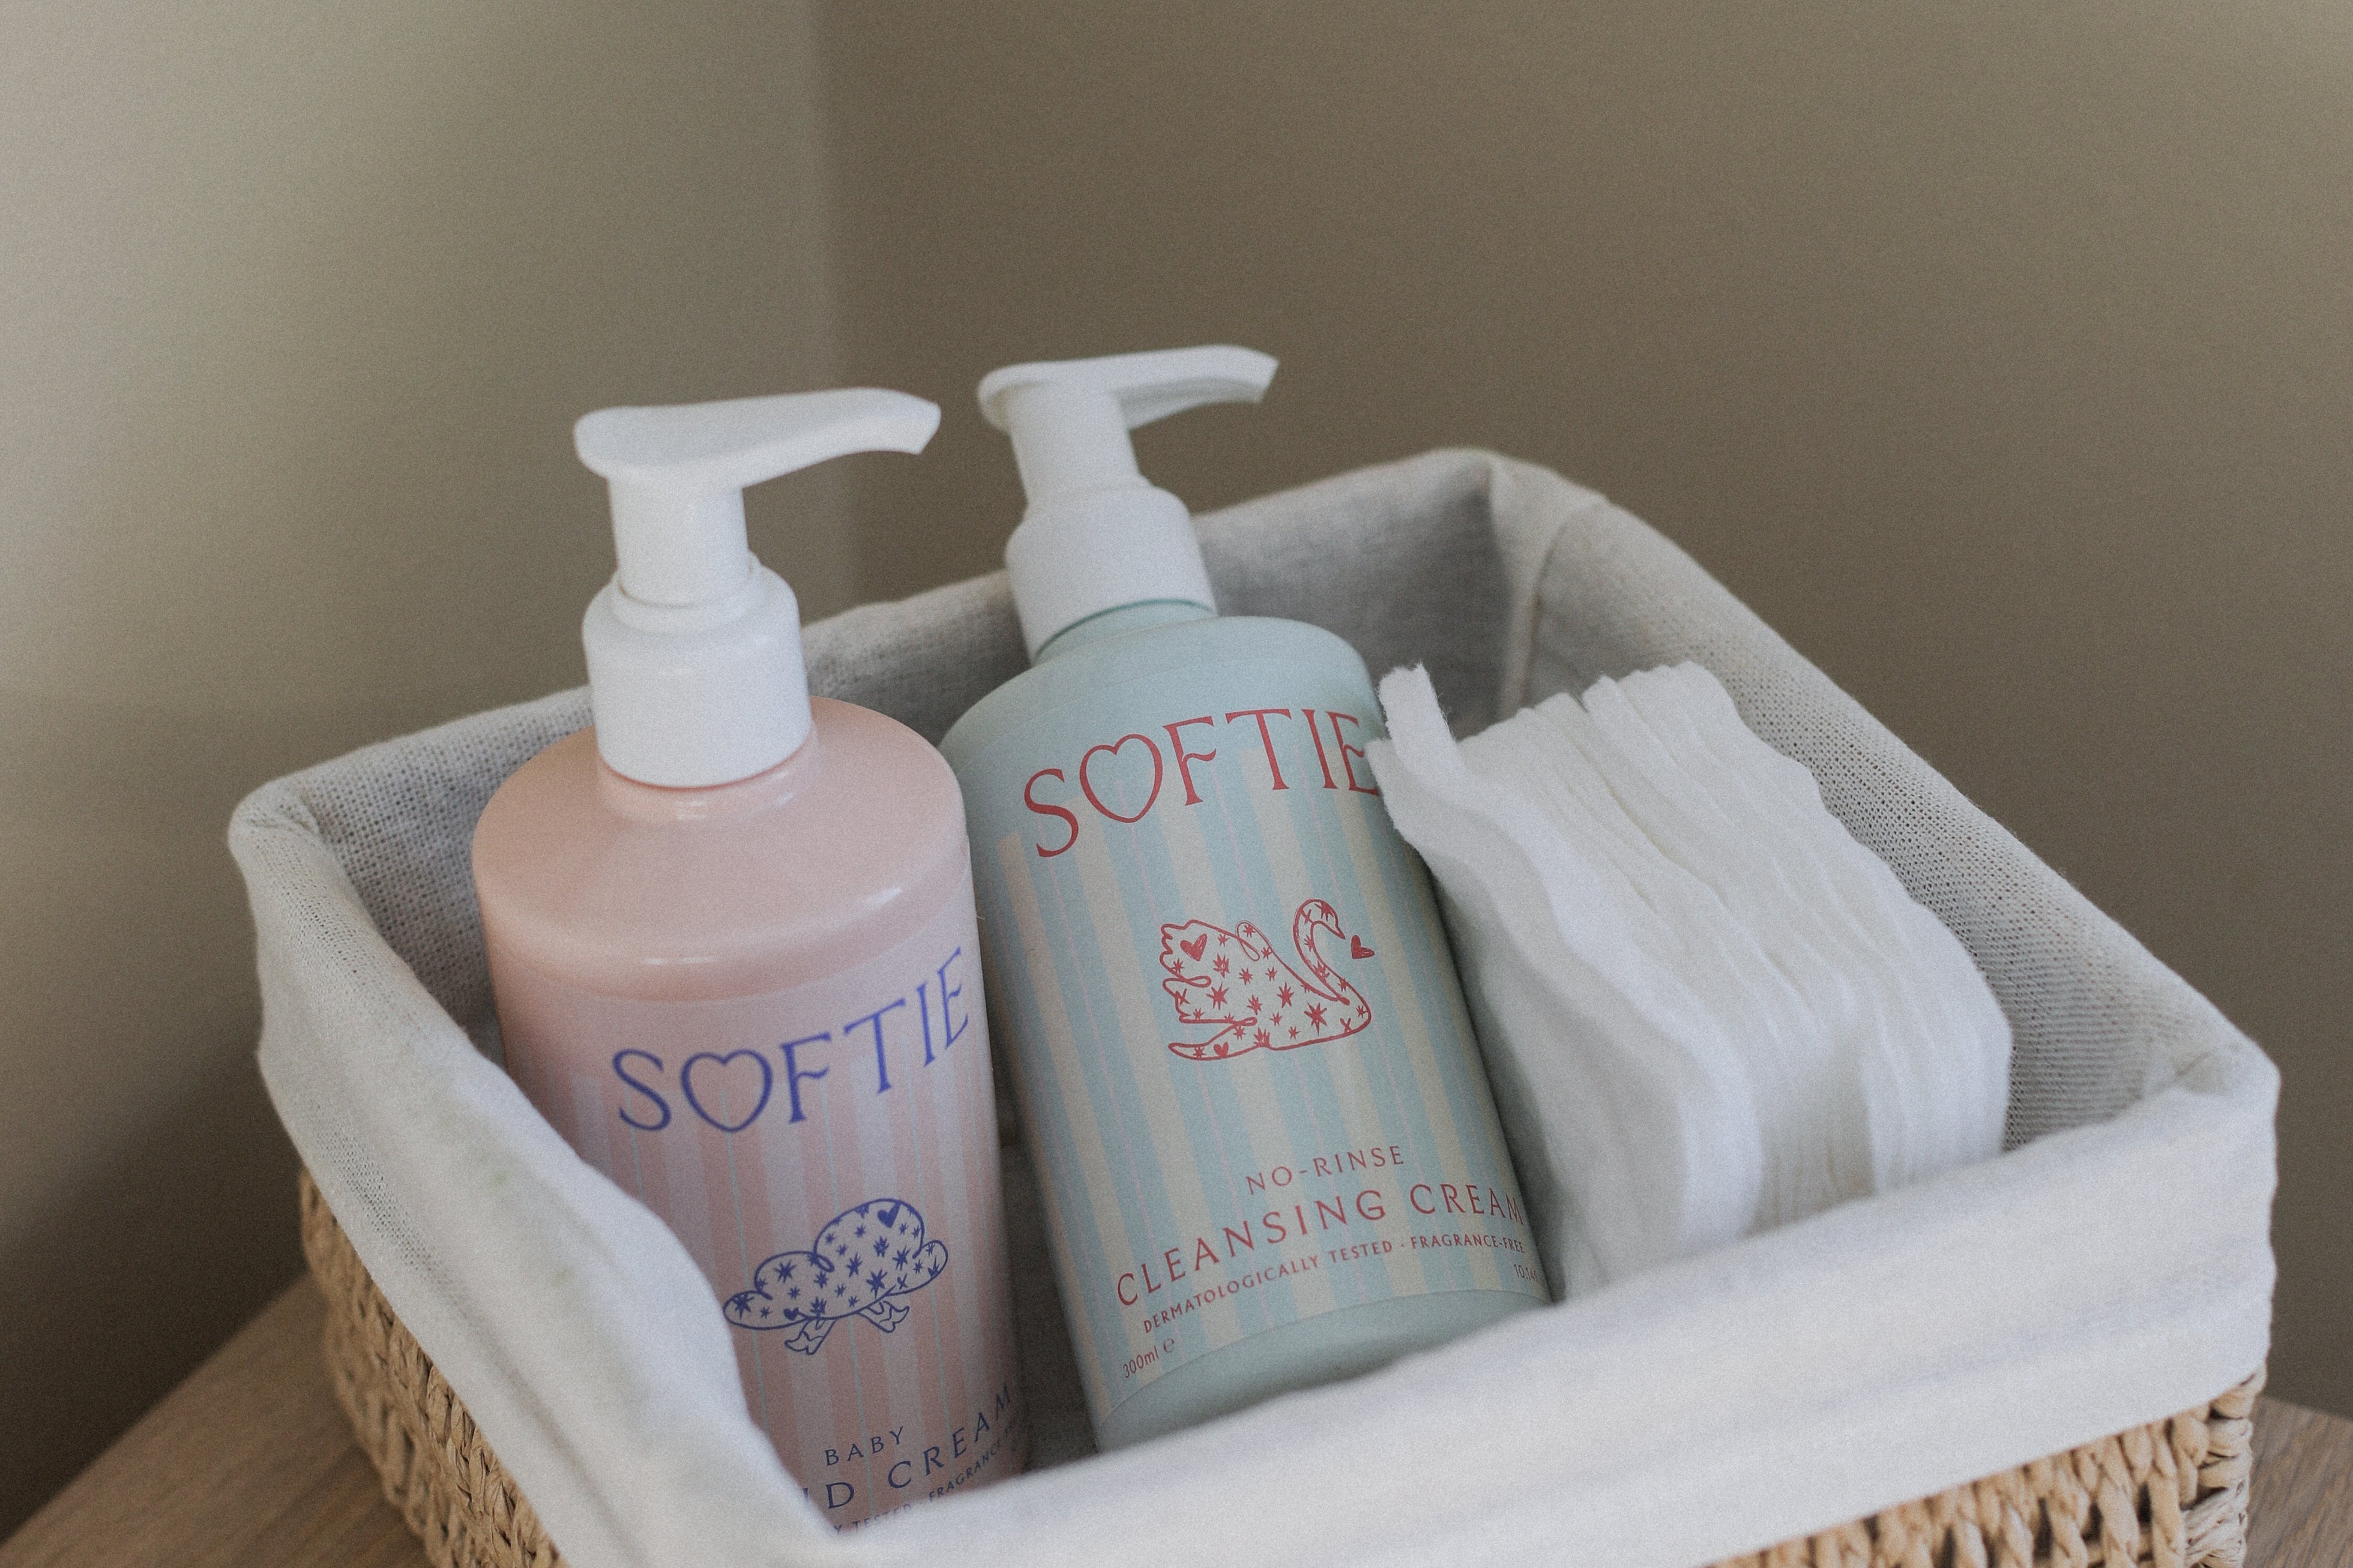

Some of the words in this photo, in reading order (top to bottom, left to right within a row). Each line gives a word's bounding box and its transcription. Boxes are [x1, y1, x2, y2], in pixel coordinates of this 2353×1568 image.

[1024, 708, 1379, 858] SOFTIE
[612, 946, 968, 1132] SOFTIE
[1247, 1146, 1405, 1195] NO-RINSE
[1116, 1189, 1385, 1306] CLEANSING
[1409, 1183, 1524, 1225] CREAM
[1143, 1255, 1319, 1333] DERMATOLOGICALLY
[1328, 1240, 1393, 1263] TESTED
[1411, 1234, 1525, 1254] FRAGRANCE-FREE
[1122, 1345, 1159, 1378] 300ml
[825, 1426, 903, 1466] BABY
[888, 1383, 1011, 1489] CREAM
